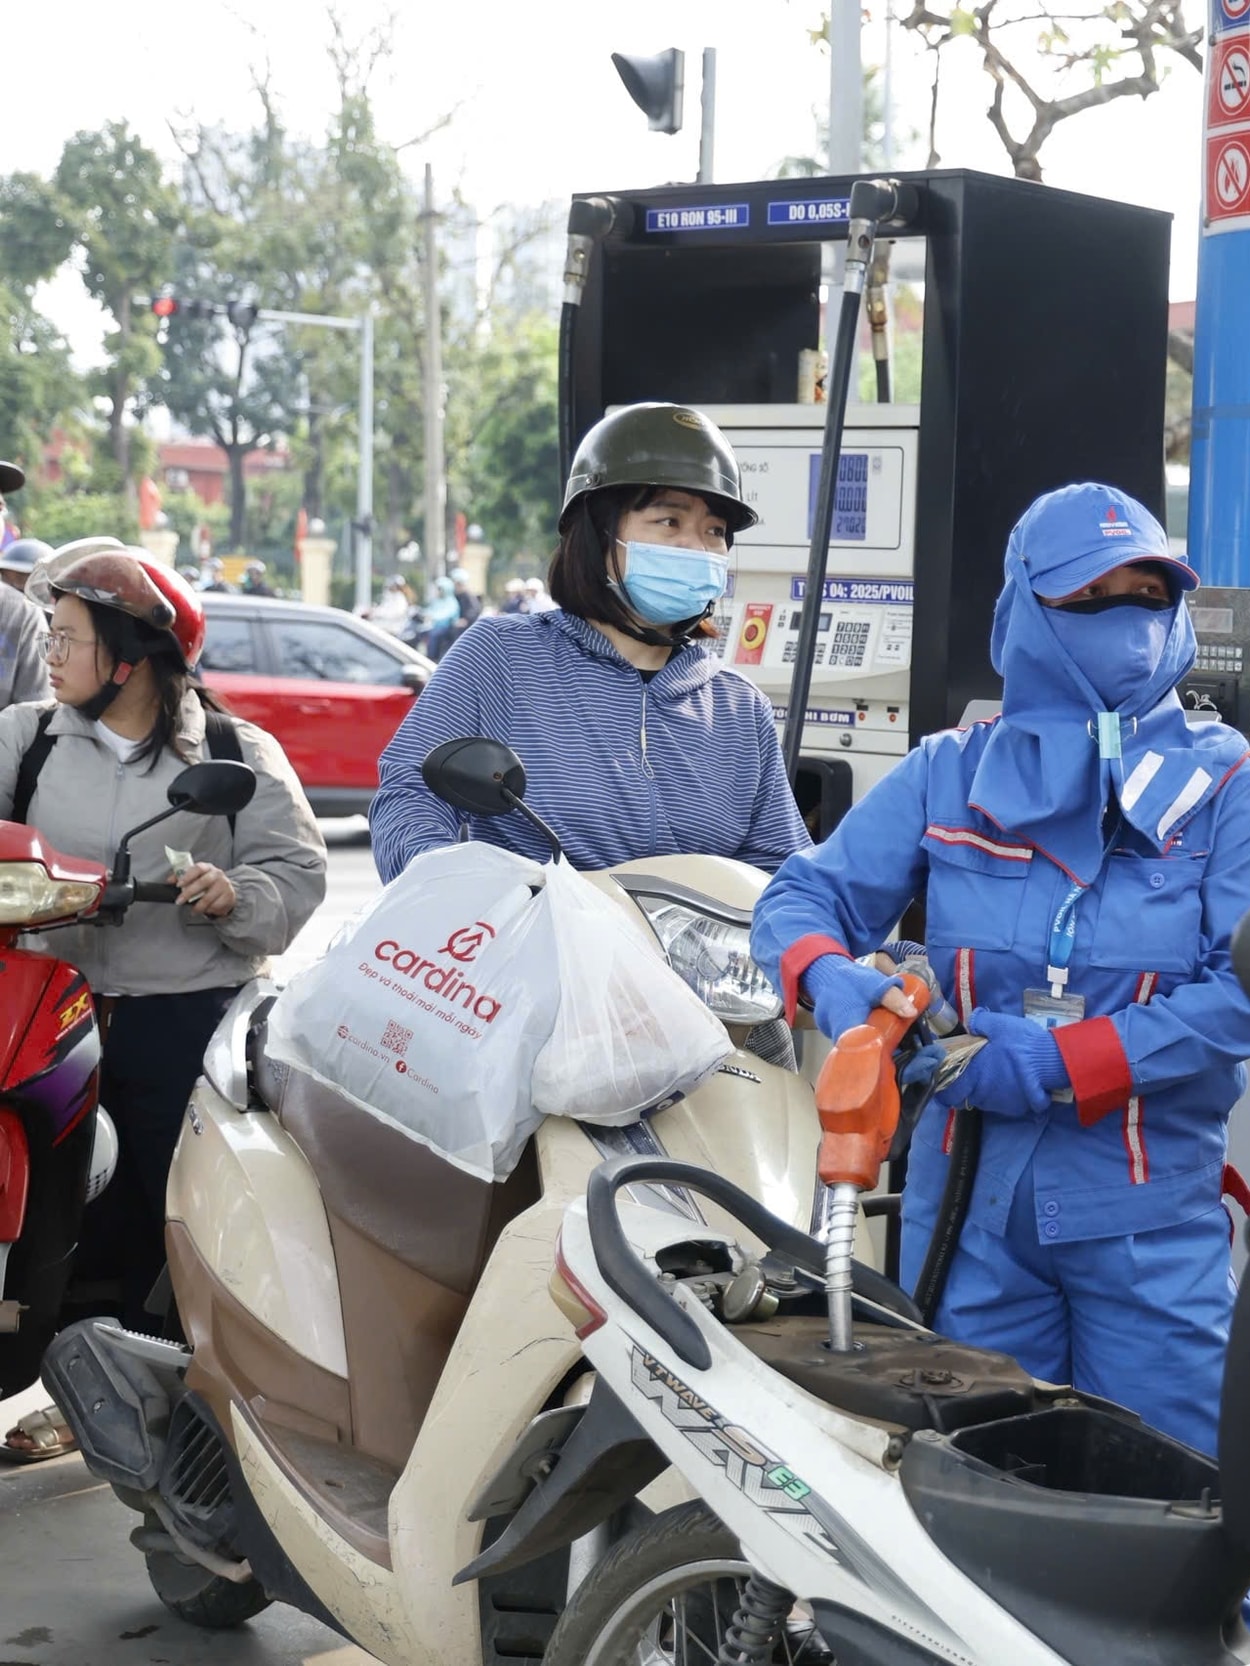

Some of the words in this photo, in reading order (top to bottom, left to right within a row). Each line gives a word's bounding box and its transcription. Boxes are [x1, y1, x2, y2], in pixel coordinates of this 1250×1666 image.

[657, 213, 678, 227] E10
[680, 211, 704, 226] RON
[707, 208, 737, 225] 95-III
[789, 205, 806, 220] DO
[830, 583, 848, 598] 04:
[374, 940, 502, 1024] cardina
[348, 1034, 390, 1063] cardina.vn
[406, 1068, 439, 1094] Cardina
